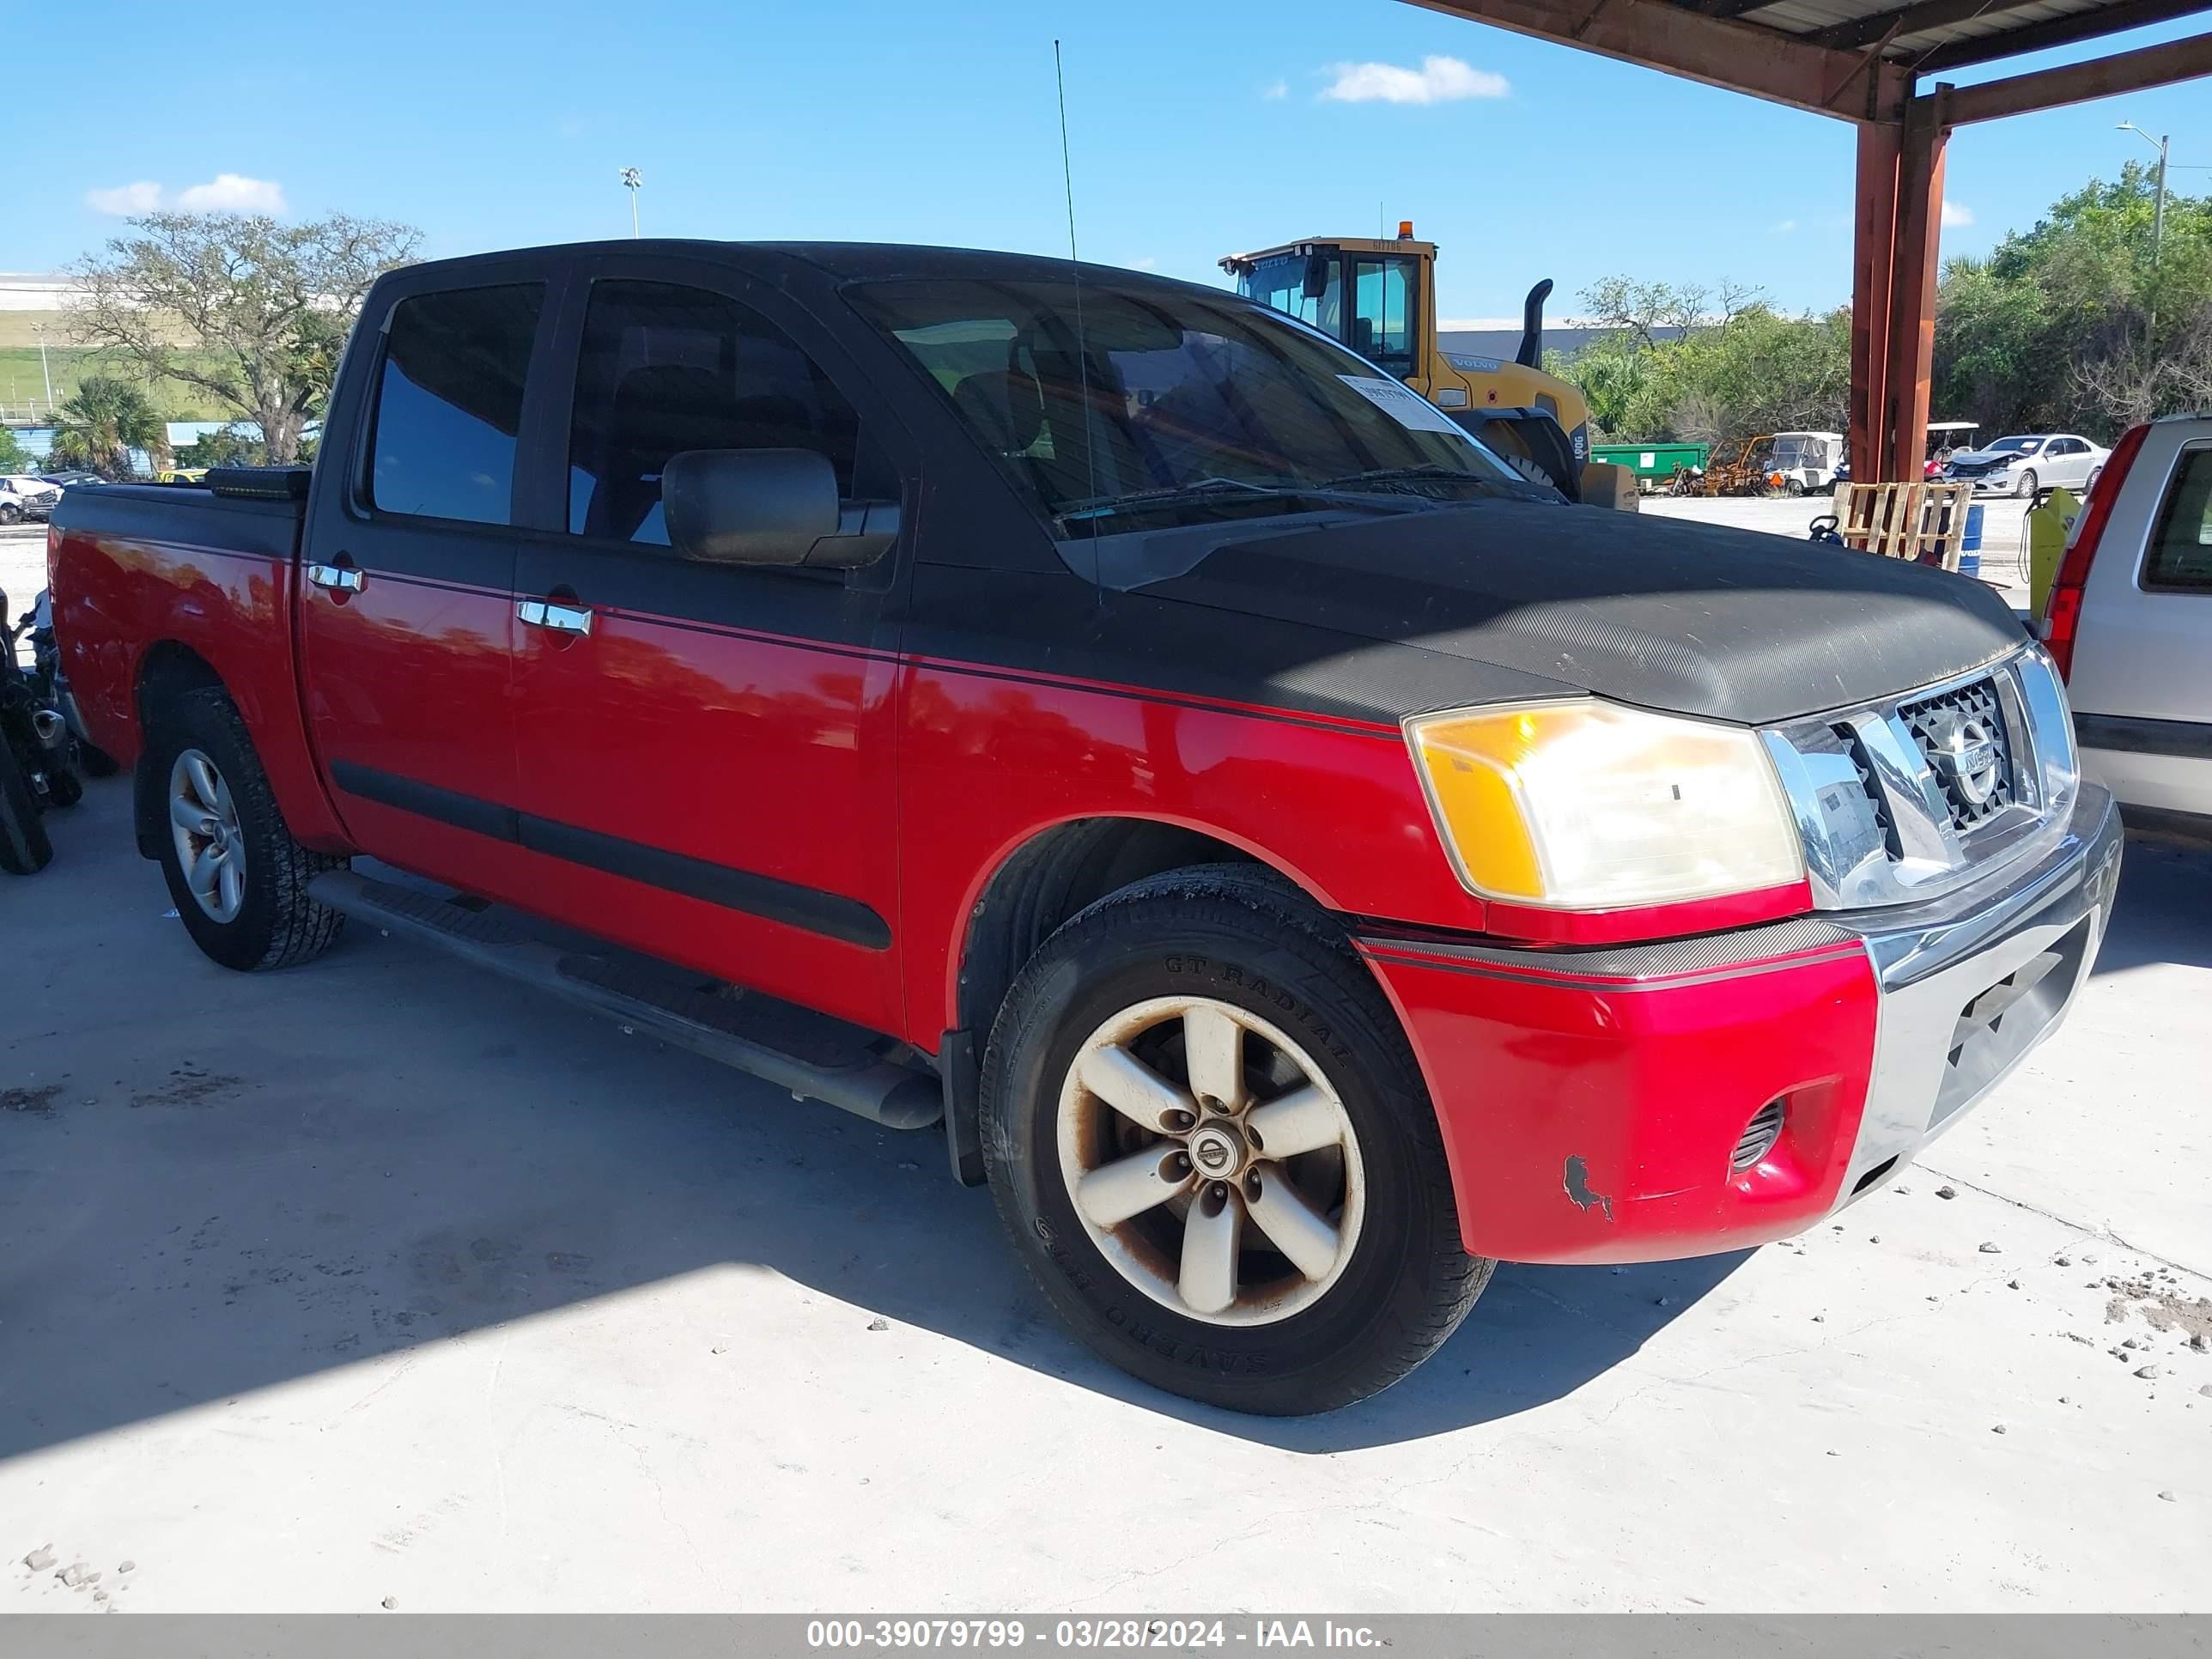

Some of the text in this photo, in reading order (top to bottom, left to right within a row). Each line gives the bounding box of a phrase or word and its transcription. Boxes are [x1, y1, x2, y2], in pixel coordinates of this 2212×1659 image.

[1453, 358, 1498, 369] VOLVO
[1574, 435, 1583, 459] L90G
[1164, 954, 1352, 1069] GT RADIAL
